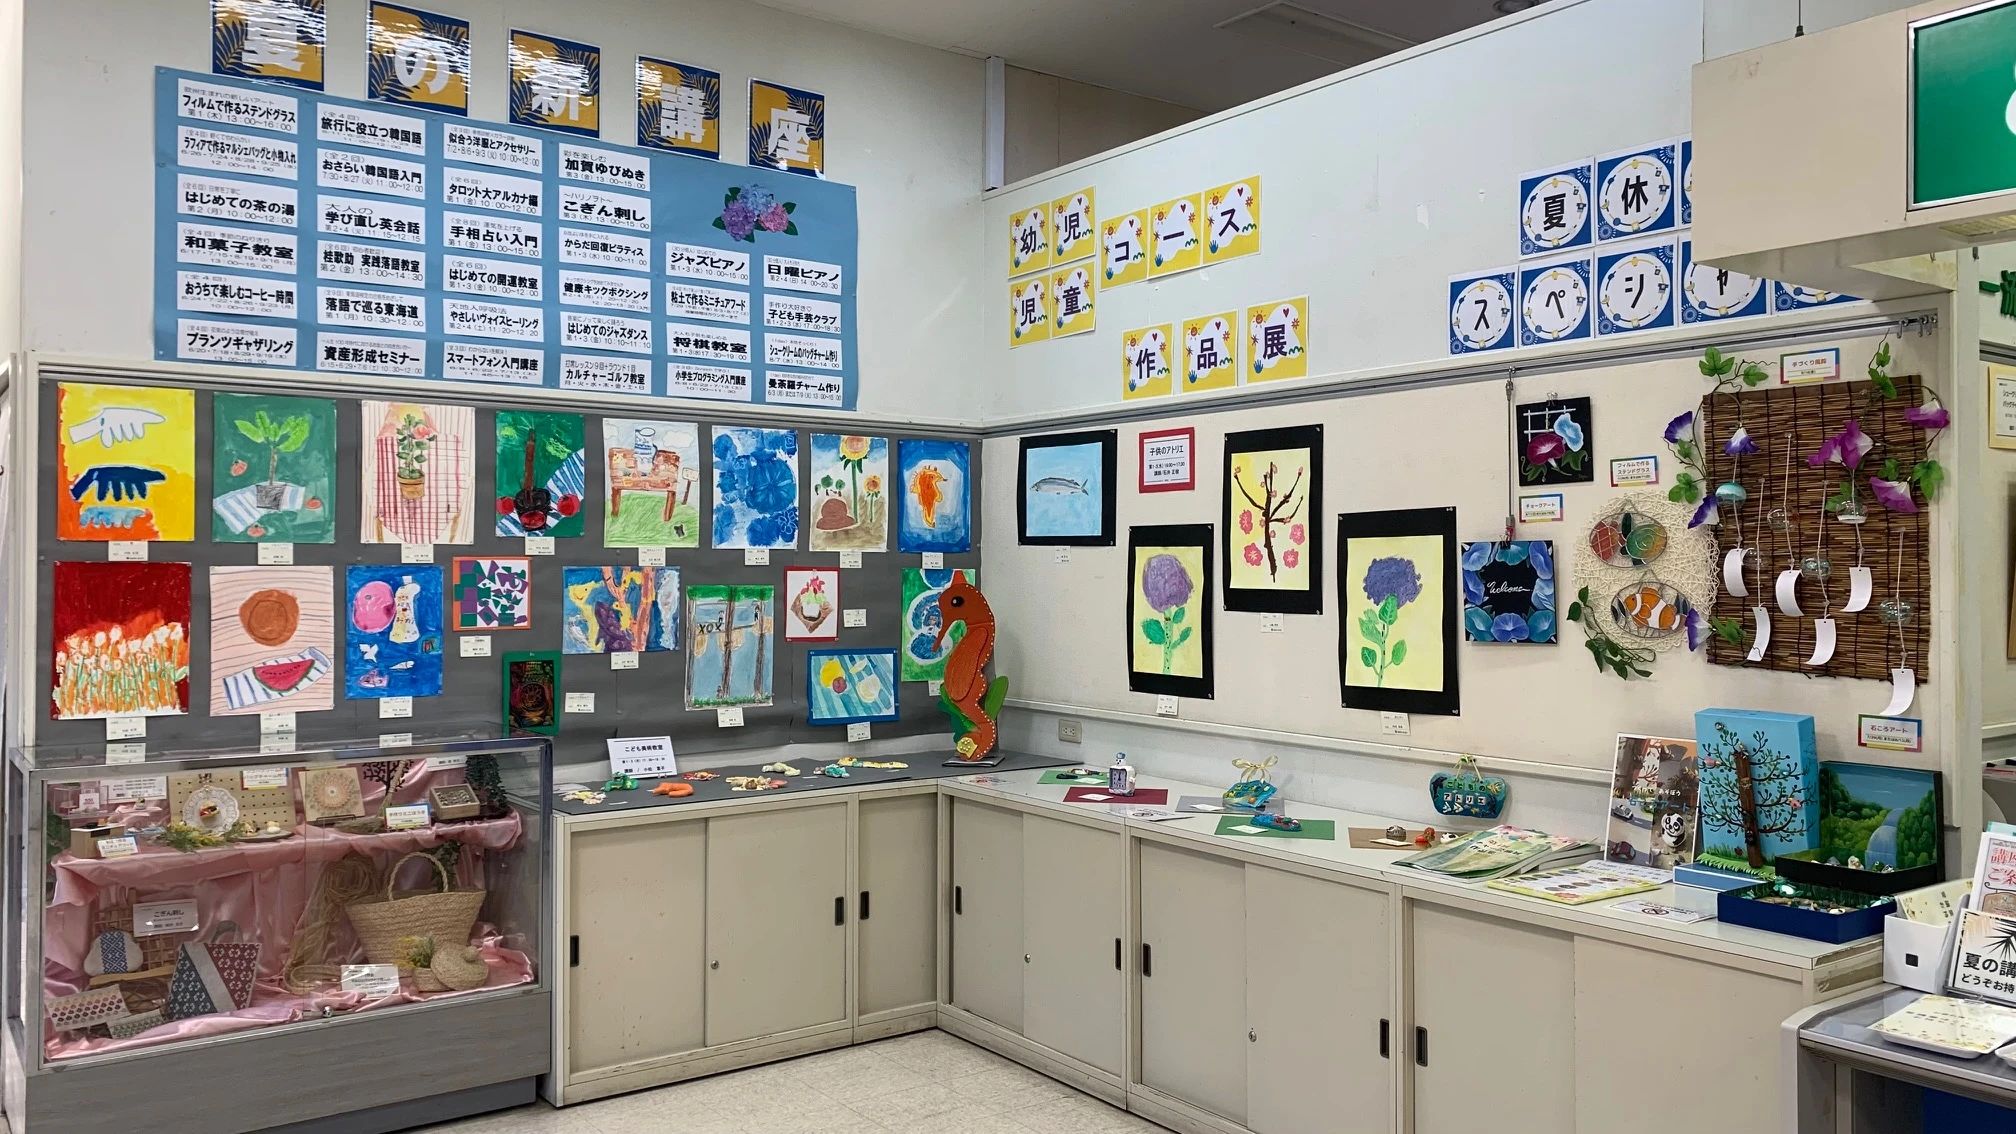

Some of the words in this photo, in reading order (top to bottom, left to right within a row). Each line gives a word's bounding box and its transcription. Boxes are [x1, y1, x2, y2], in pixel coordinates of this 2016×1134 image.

[183, 94, 296, 123] フィルムで作るステンドグラス
[321, 117, 422, 144] 旅行に役立つ韓国語
[184, 137, 296, 164] ラフィアで作るマルシェバッグと小物入れ
[449, 133, 535, 154] 似合う洋服とアクセサリー
[322, 160, 422, 184] おさらい韓国語入門
[565, 158, 645, 182] 加賀ゆびぬき
[185, 191, 295, 216] はじめての茶の湯
[449, 184, 538, 207] タロット大アルカナ編
[325, 204, 373, 215] 大人の
[564, 200, 645, 222] こぎん刺し
[325, 211, 420, 235] 学び直し英会話
[1020, 212, 1080, 254] 幼児
[450, 226, 538, 248] 手相占い入門
[1115, 208, 1240, 262] コース
[185, 236, 294, 260] 和菓子教室
[564, 239, 644, 256] からだ回復ピラティス
[323, 250, 354, 265] 桂歌助
[361, 254, 420, 273] 実践落語教室
[670, 252, 745, 272] ジャズピアノ
[449, 269, 538, 290] はじめての開運教室
[768, 264, 839, 282] 日曜ピアノ
[185, 282, 294, 305] おうちで楽しむコーヒー時間
[564, 283, 648, 300] 健康キックボクシング
[671, 291, 745, 311] 粘土で作るミニチュアフード
[326, 298, 419, 319] 落語で巡る東海道
[1020, 286, 1081, 326] 児童
[450, 311, 539, 329] やさしいヴォイスヒーリング
[768, 309, 837, 325] 子ども手芸クラブ
[567, 323, 648, 340] はじめてのジャズダンス
[187, 332, 294, 354] プランツギャザリング
[673, 336, 747, 354] 将棋教室
[1135, 324, 1287, 379] 作品展
[324, 346, 420, 364] 資産形成セミナー
[447, 353, 538, 371] スマートフォン入門講座
[566, 369, 645, 385] カルチャーゴルフ教室
[675, 371, 746, 386] 小学生プログラミング入門講座
[769, 379, 840, 393] 曼荼羅チャーム作り
[1149, 445, 1184, 456] 子供のアトリエ
[1870, 724, 1909, 734] 石ころアート
[1444, 793, 1486, 804] アトリエ
